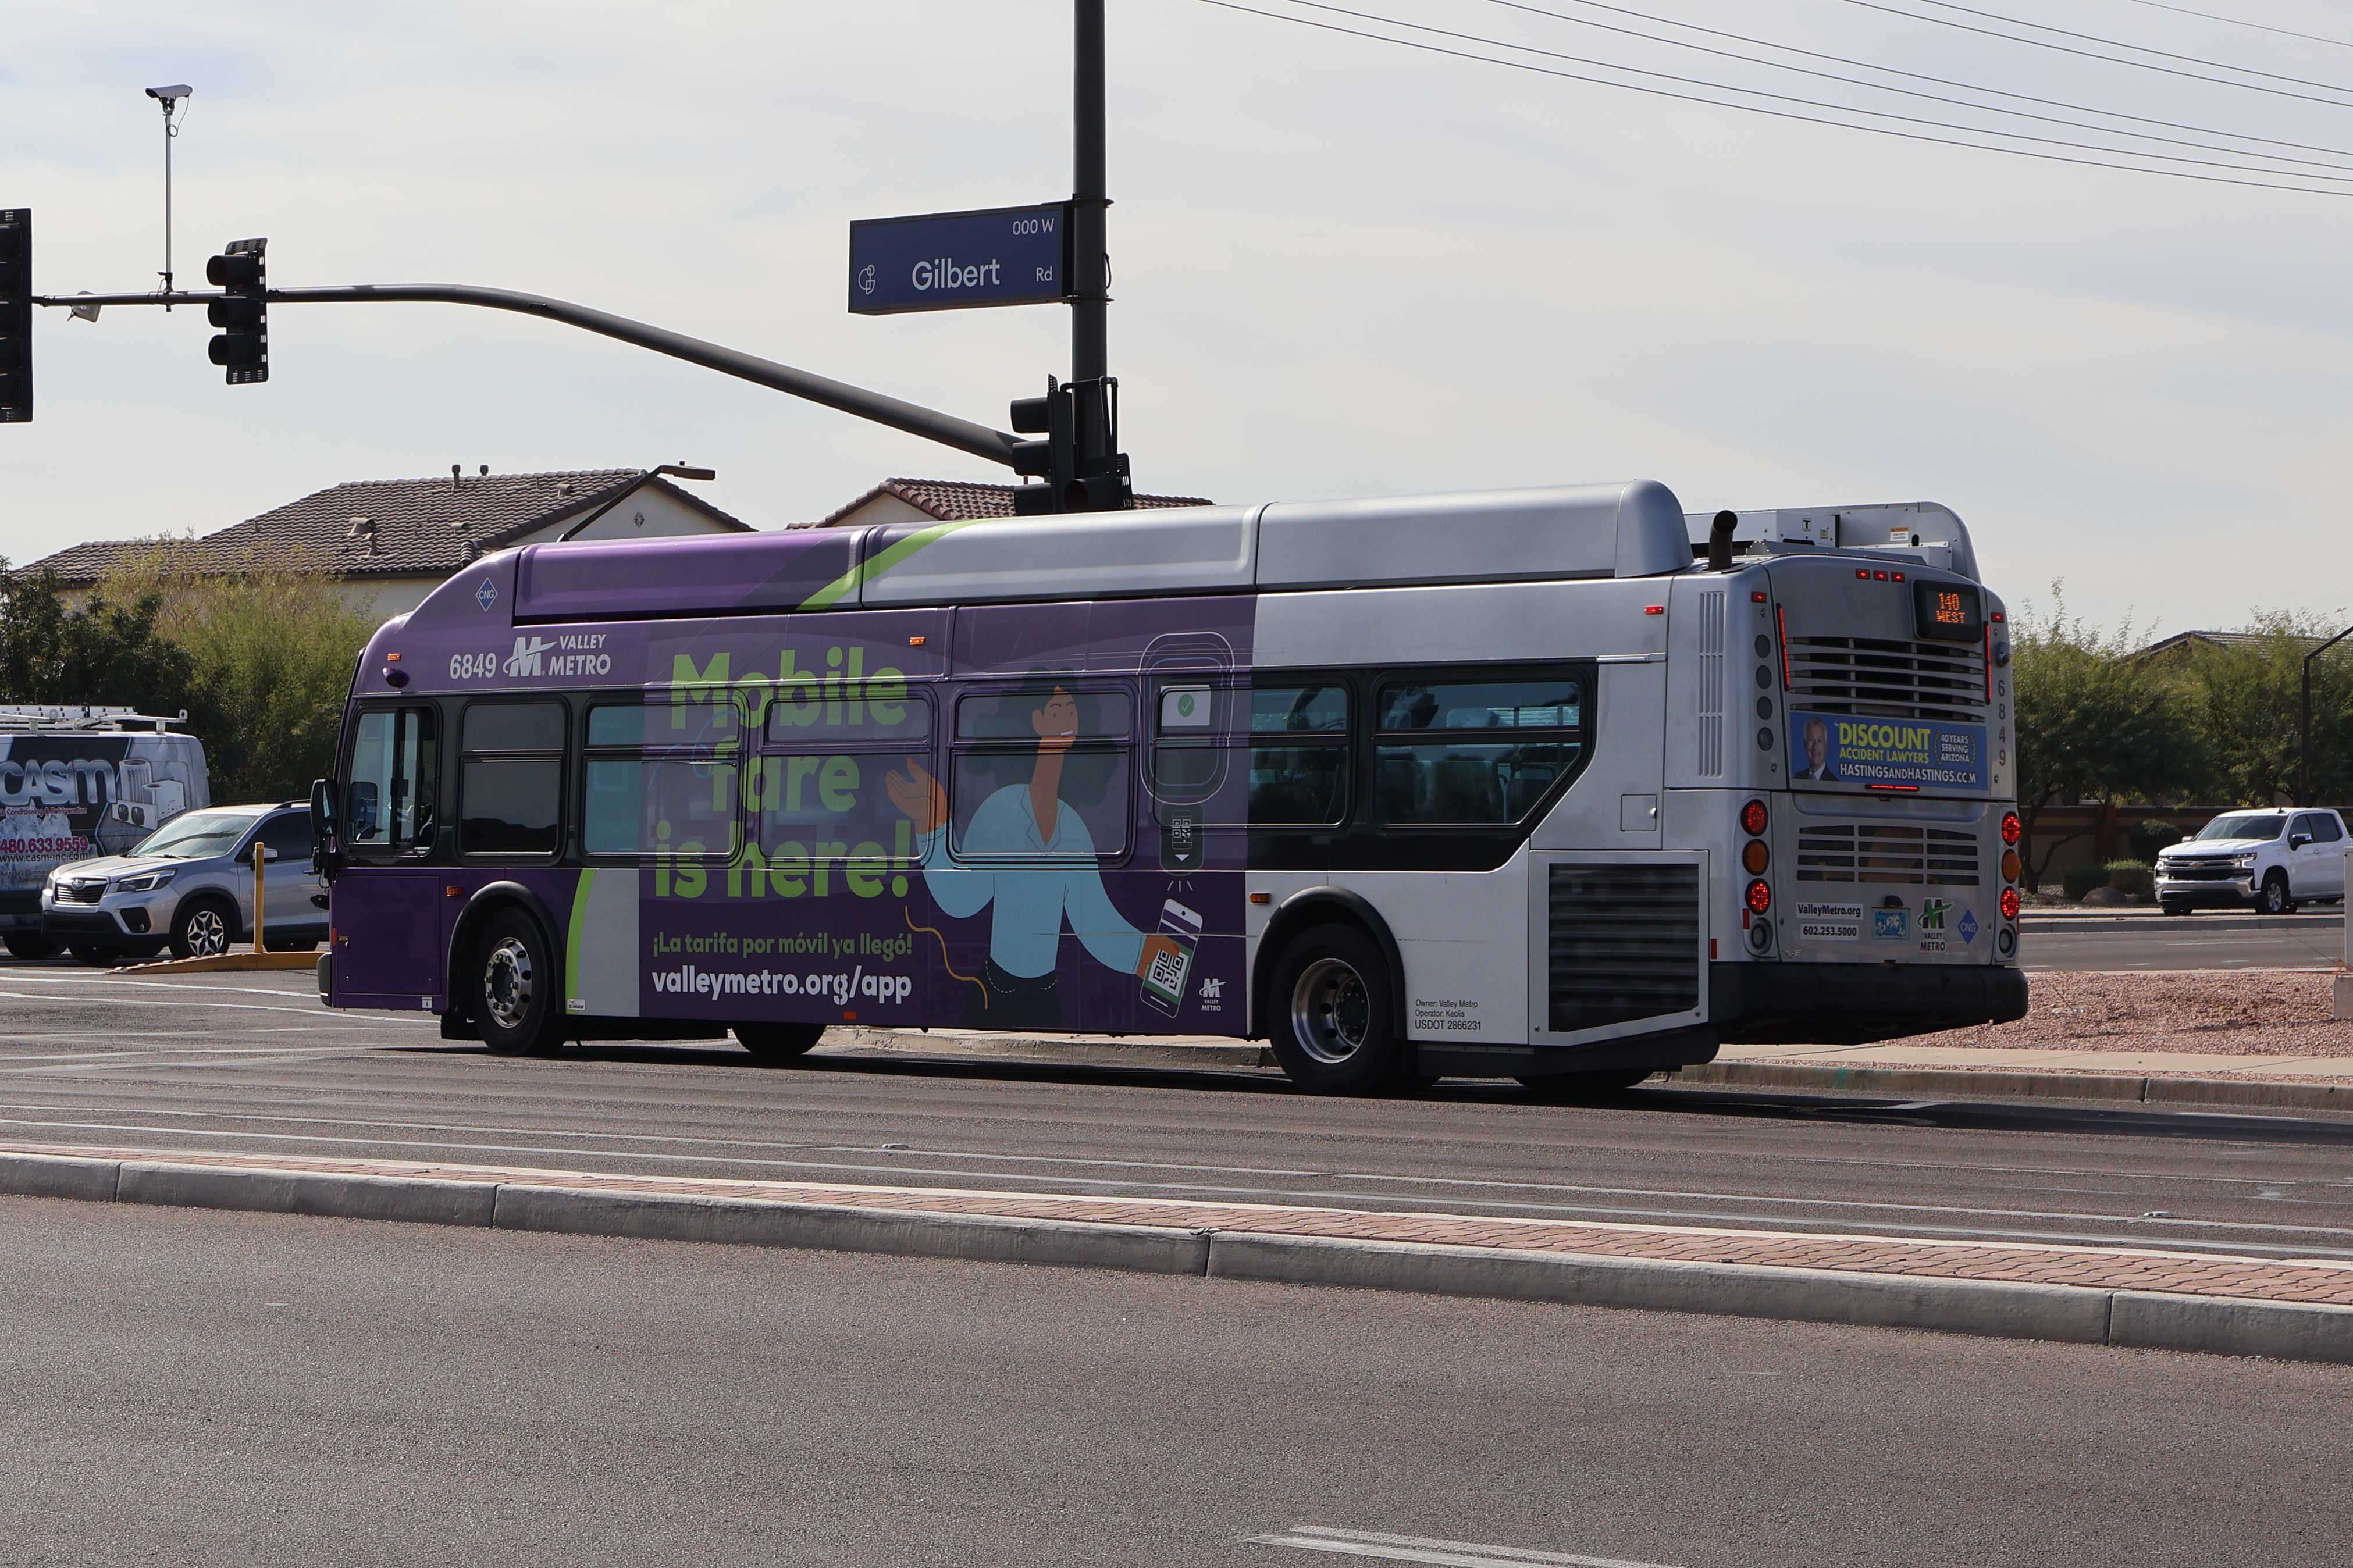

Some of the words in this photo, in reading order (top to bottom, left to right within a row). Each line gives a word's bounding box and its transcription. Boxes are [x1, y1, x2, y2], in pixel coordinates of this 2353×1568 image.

[1013, 219, 1038, 235] 000
[1042, 218, 1055, 233] W
[912, 258, 1000, 290] Gilbert
[1036, 265, 1052, 281] Rd
[479, 590, 494, 600] CNG
[1938, 592, 1960, 610] 140
[1936, 611, 1965, 624] WEST
[560, 634, 606, 650] VALLEY
[450, 653, 497, 679] 6849
[549, 654, 611, 676] METRO
[671, 647, 909, 729] Mobile
[1839, 722, 1931, 750] DISCOUNT
[1949, 735, 1968, 744] YEARS
[1942, 743, 1968, 753] SERVING
[1839, 747, 1884, 761] ACCIDENT
[1886, 751, 1929, 764] LAWYERS
[1941, 753, 1970, 762] ARIZONA
[712, 735, 860, 812] fare
[6, 808, 43, 817] Conditioning
[0, 838, 88, 853] 480.633.9559
[656, 820, 707, 899] is
[727, 820, 910, 899] here!
[1798, 904, 1861, 917] ValleyMetro.org
[1803, 926, 1857, 937] 602.253.5000
[1960, 922, 1976, 932] CNG
[653, 932, 681, 957] ¡La
[685, 932, 738, 953] tarifa
[743, 936, 775, 958] por
[779, 932, 828, 954] móvil
[832, 938, 855, 959] ya
[860, 933, 912, 962] llegó!
[1921, 942, 1945, 952] METRO
[652, 965, 912, 1005] valleymetro.org/app
[1439, 1000, 1457, 1008] Valley
[1415, 1010, 1444, 1018] Operator:
[1415, 1020, 1445, 1029] USDOT
[1447, 1020, 1481, 1030] 2866231
